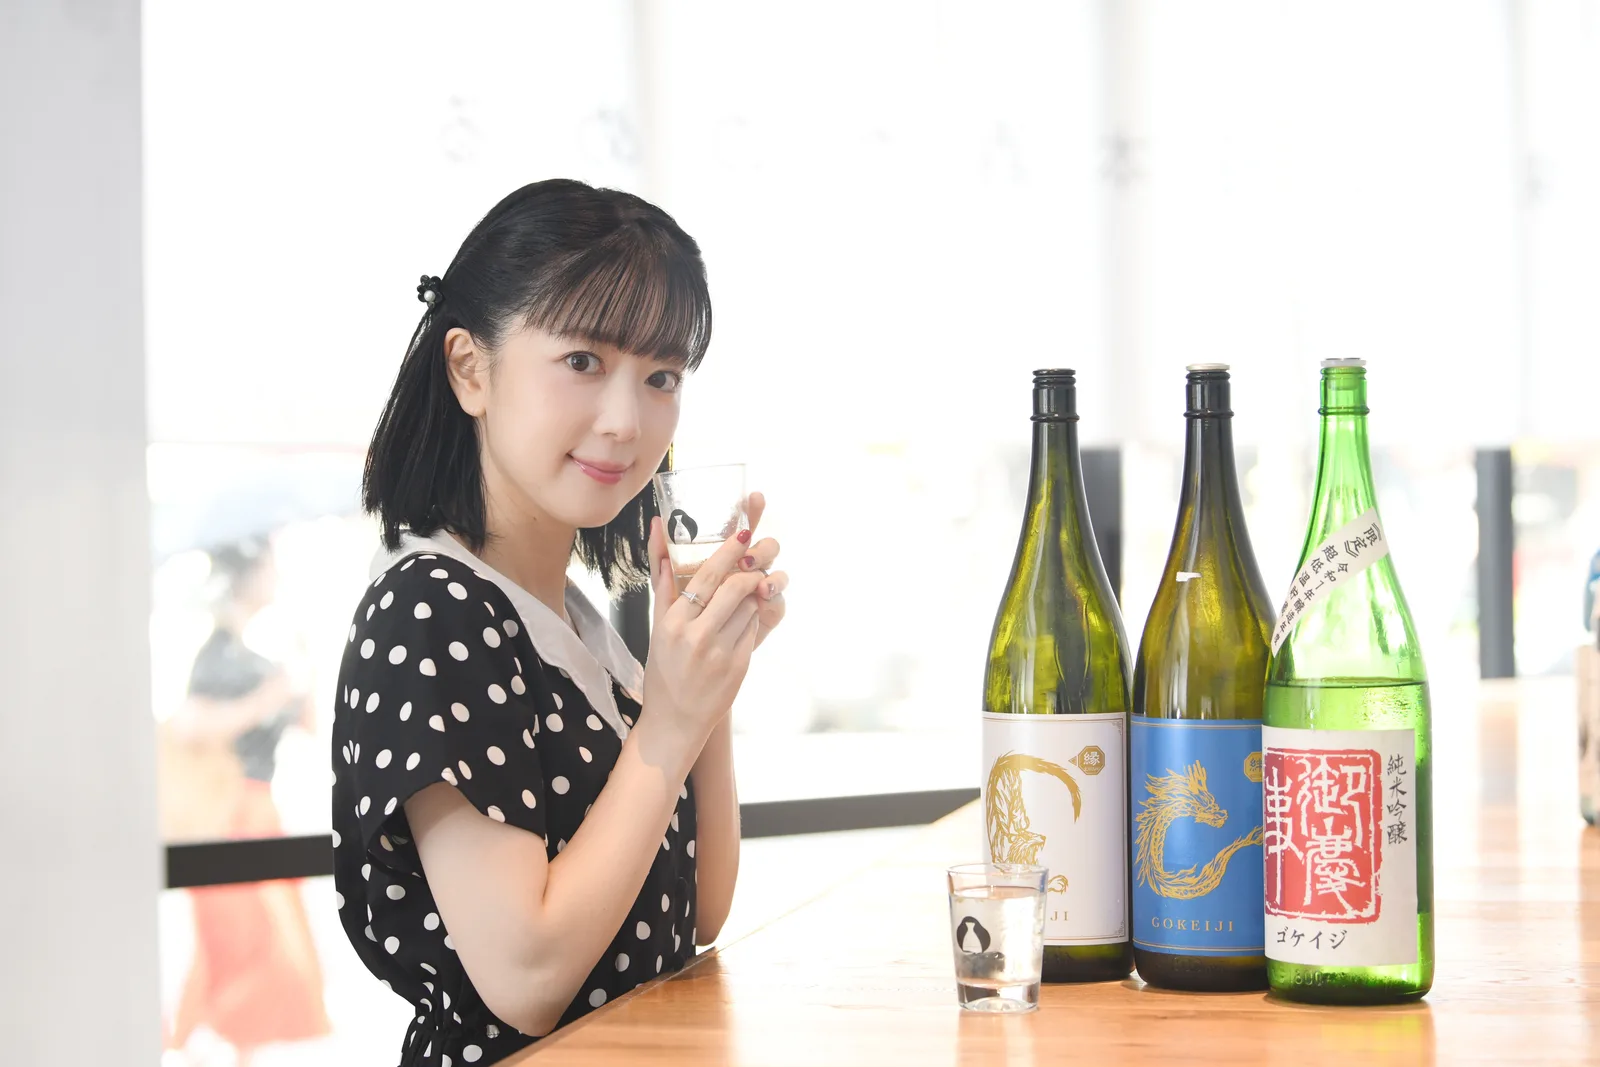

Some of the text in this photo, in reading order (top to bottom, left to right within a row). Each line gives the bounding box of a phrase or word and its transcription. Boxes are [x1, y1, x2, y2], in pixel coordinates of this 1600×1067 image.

[1387, 753, 1407, 845] 純米吟醸
[1151, 916, 1235, 932] GOKEIJI
[1276, 926, 1348, 950] ゴケイジ
